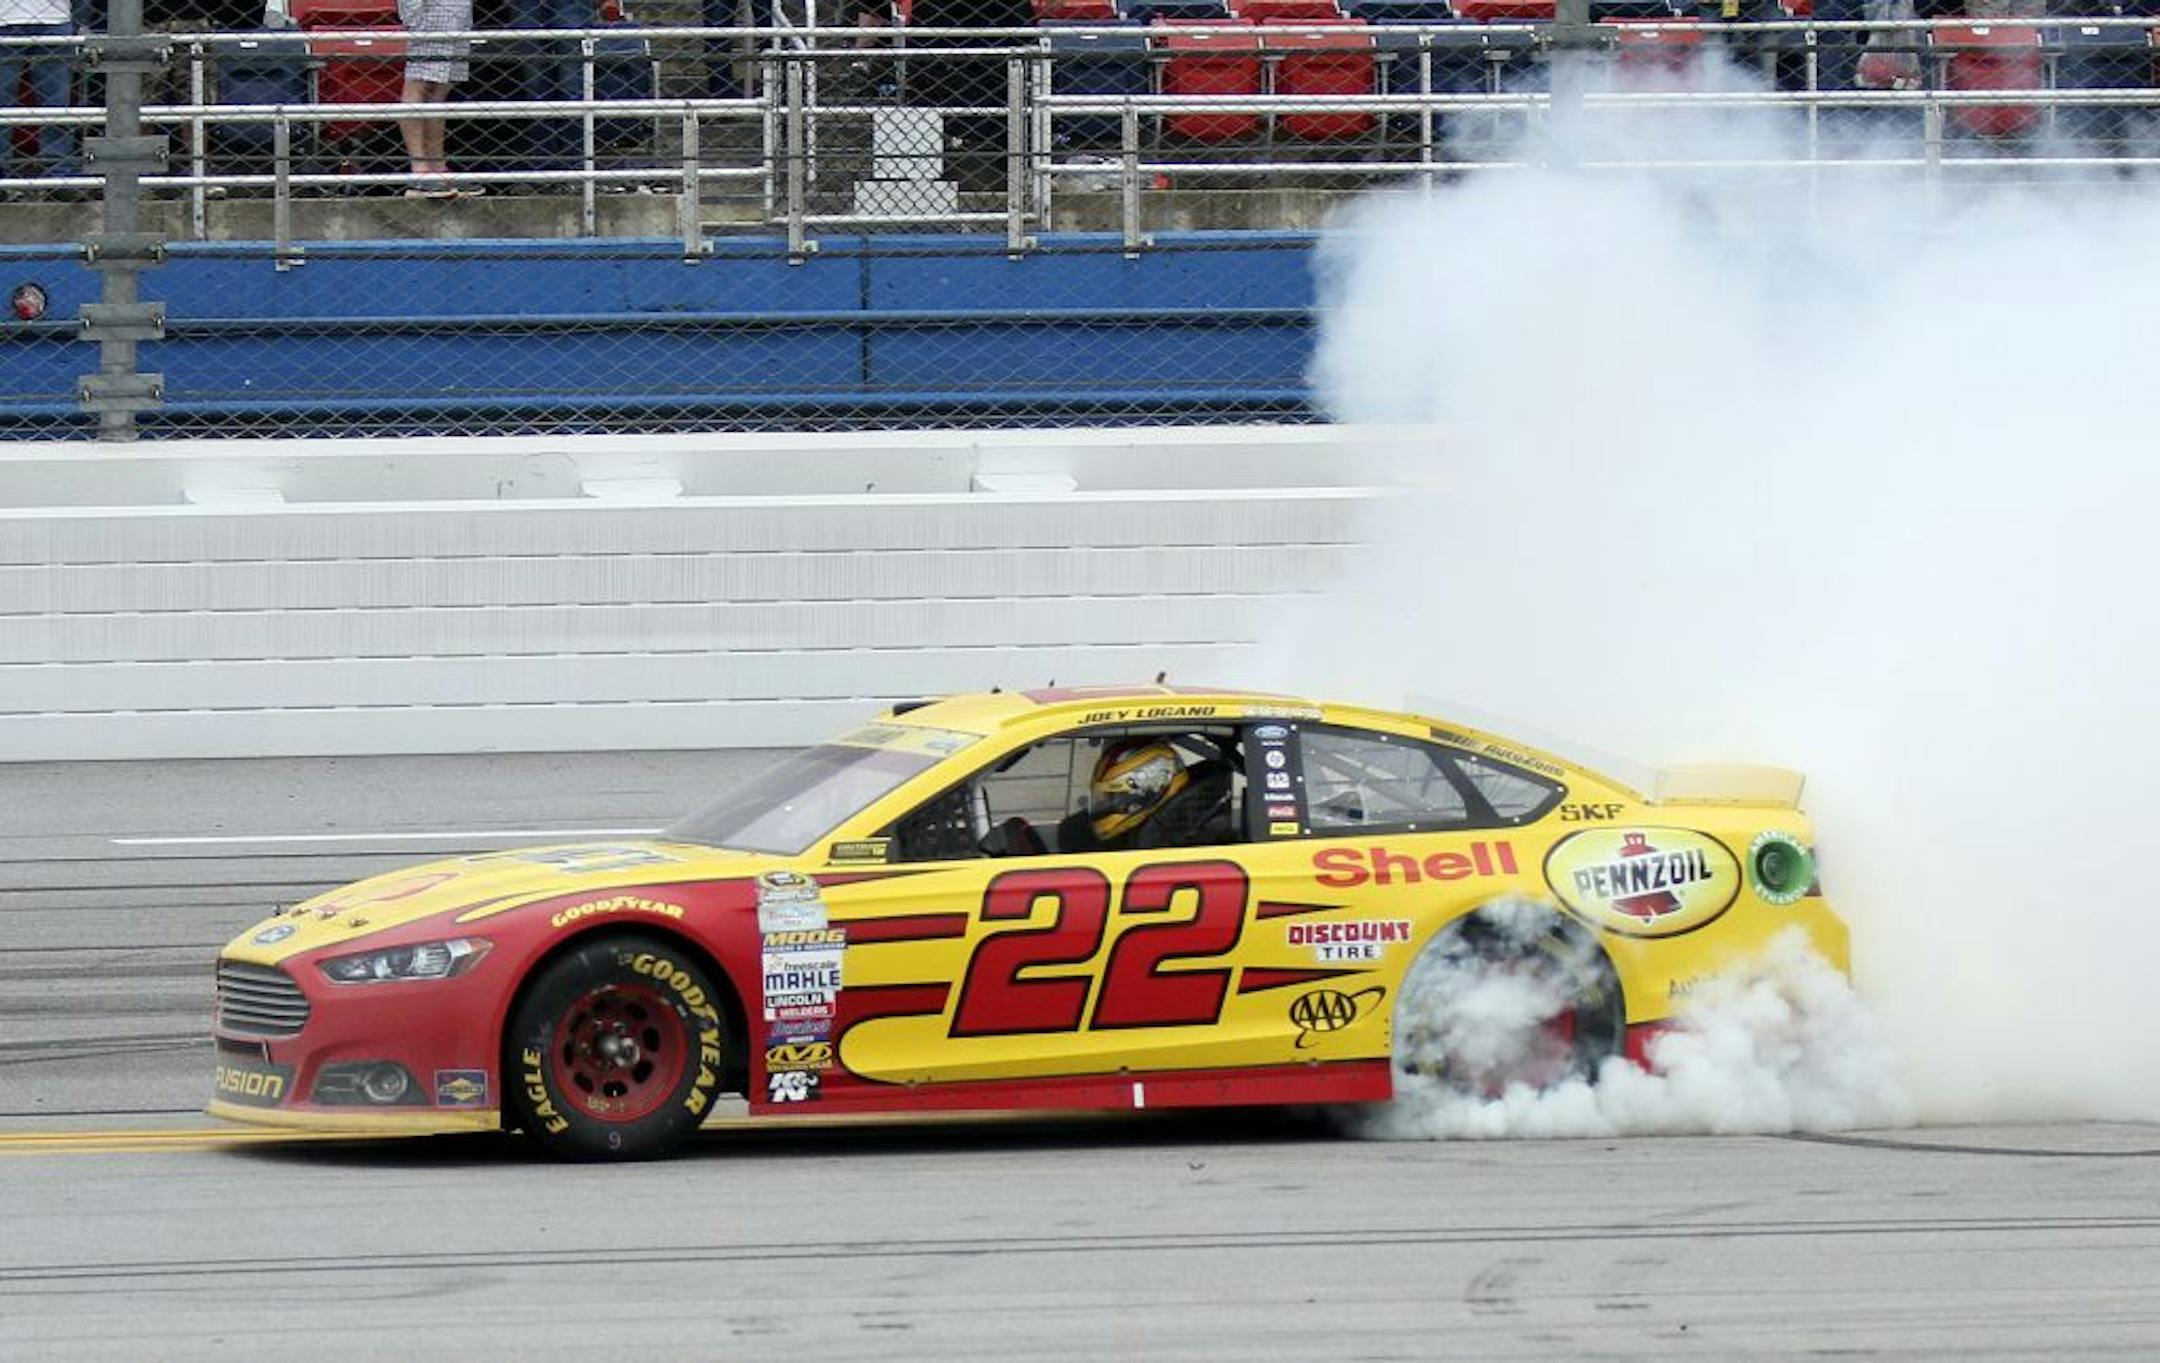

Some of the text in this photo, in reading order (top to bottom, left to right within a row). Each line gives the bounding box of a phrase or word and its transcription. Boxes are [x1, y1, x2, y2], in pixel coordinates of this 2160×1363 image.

[1078, 706, 1215, 724] JOEY LOGANO
[1560, 803, 1625, 822] SKF
[1312, 841, 1519, 888] Shell
[1573, 847, 1713, 898] PENNZOIL
[551, 896, 684, 928] GOODYEAR
[763, 928, 848, 946] MOOG
[1288, 921, 1411, 945] DISCOUNT
[947, 859, 1250, 1038] 22
[1322, 945, 1375, 960] TIRE
[765, 969, 841, 990] MAHLE
[767, 992, 823, 1008] LINCOLN
[1298, 991, 1349, 1031] AAA
[631, 954, 721, 1115] GOODYEAR
[522, 1048, 569, 1134] EAGLE
